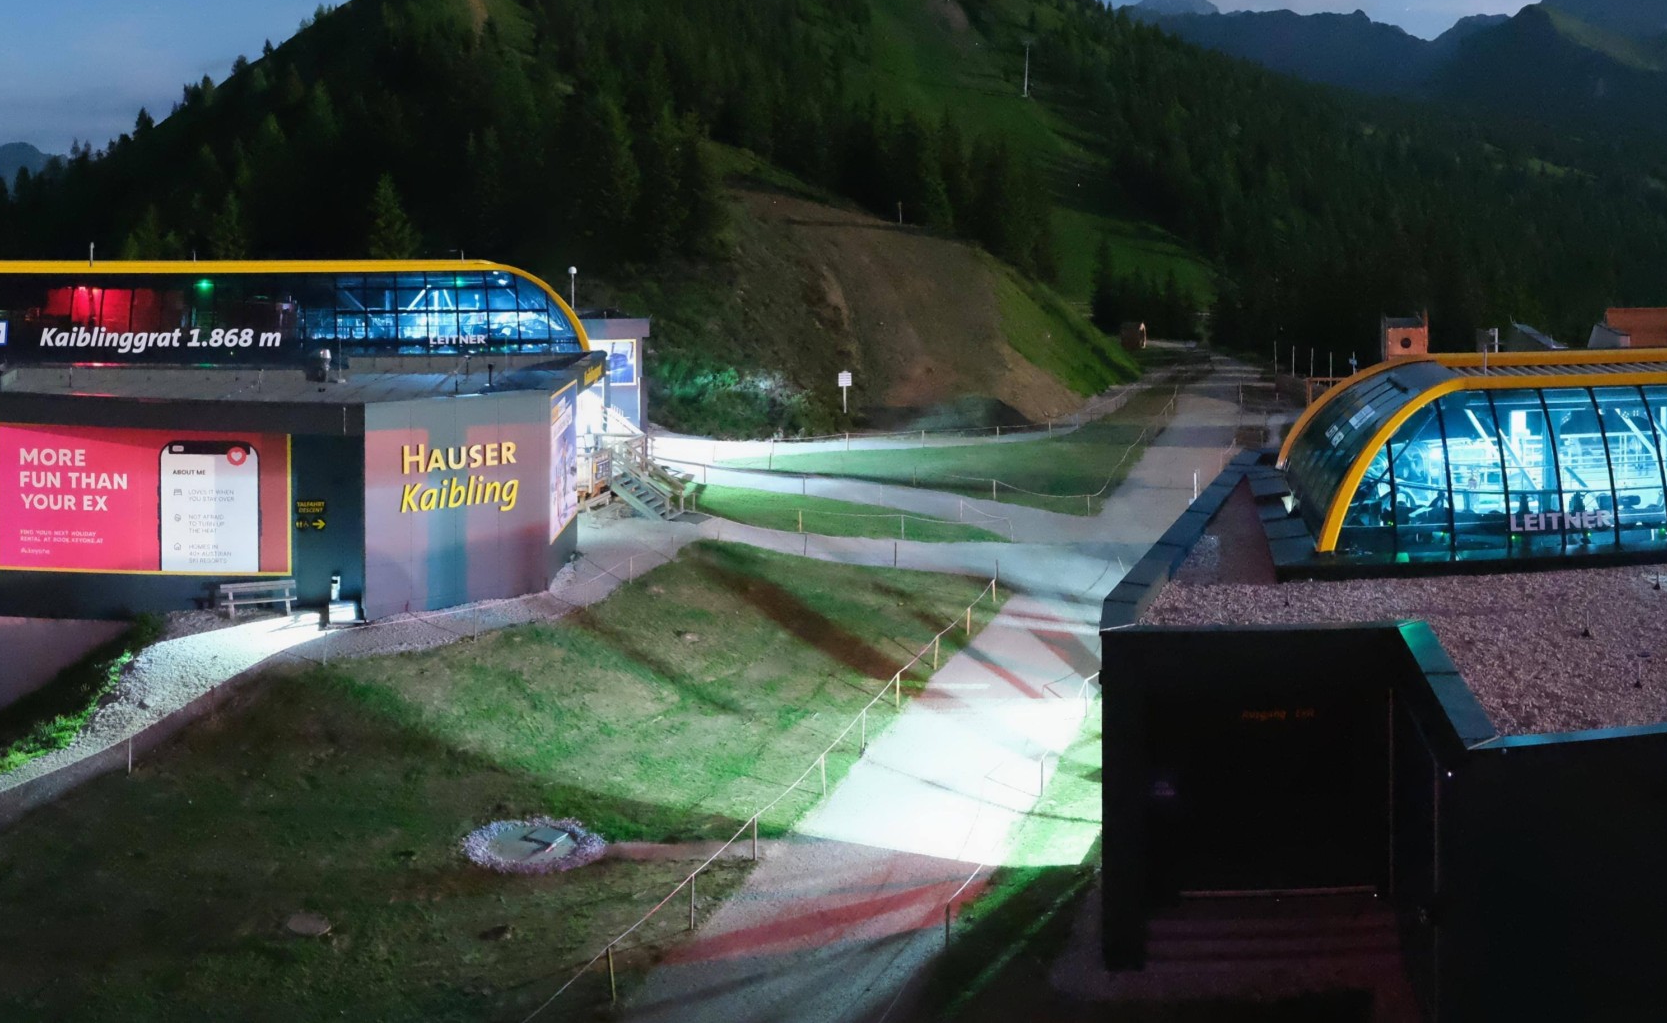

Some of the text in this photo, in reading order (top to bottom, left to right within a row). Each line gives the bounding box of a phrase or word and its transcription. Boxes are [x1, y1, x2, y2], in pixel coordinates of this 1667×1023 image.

[39, 327, 281, 354] Kaiblinggrat 1.868 m
[429, 334, 486, 345] LEITNER
[19, 448, 86, 467] MORE
[401, 441, 517, 475] HAUSER
[19, 471, 127, 490] FUN THAN
[21, 493, 108, 511] YOUR EX
[400, 475, 519, 514] Kaibling
[1509, 510, 1612, 532] LEITNER
